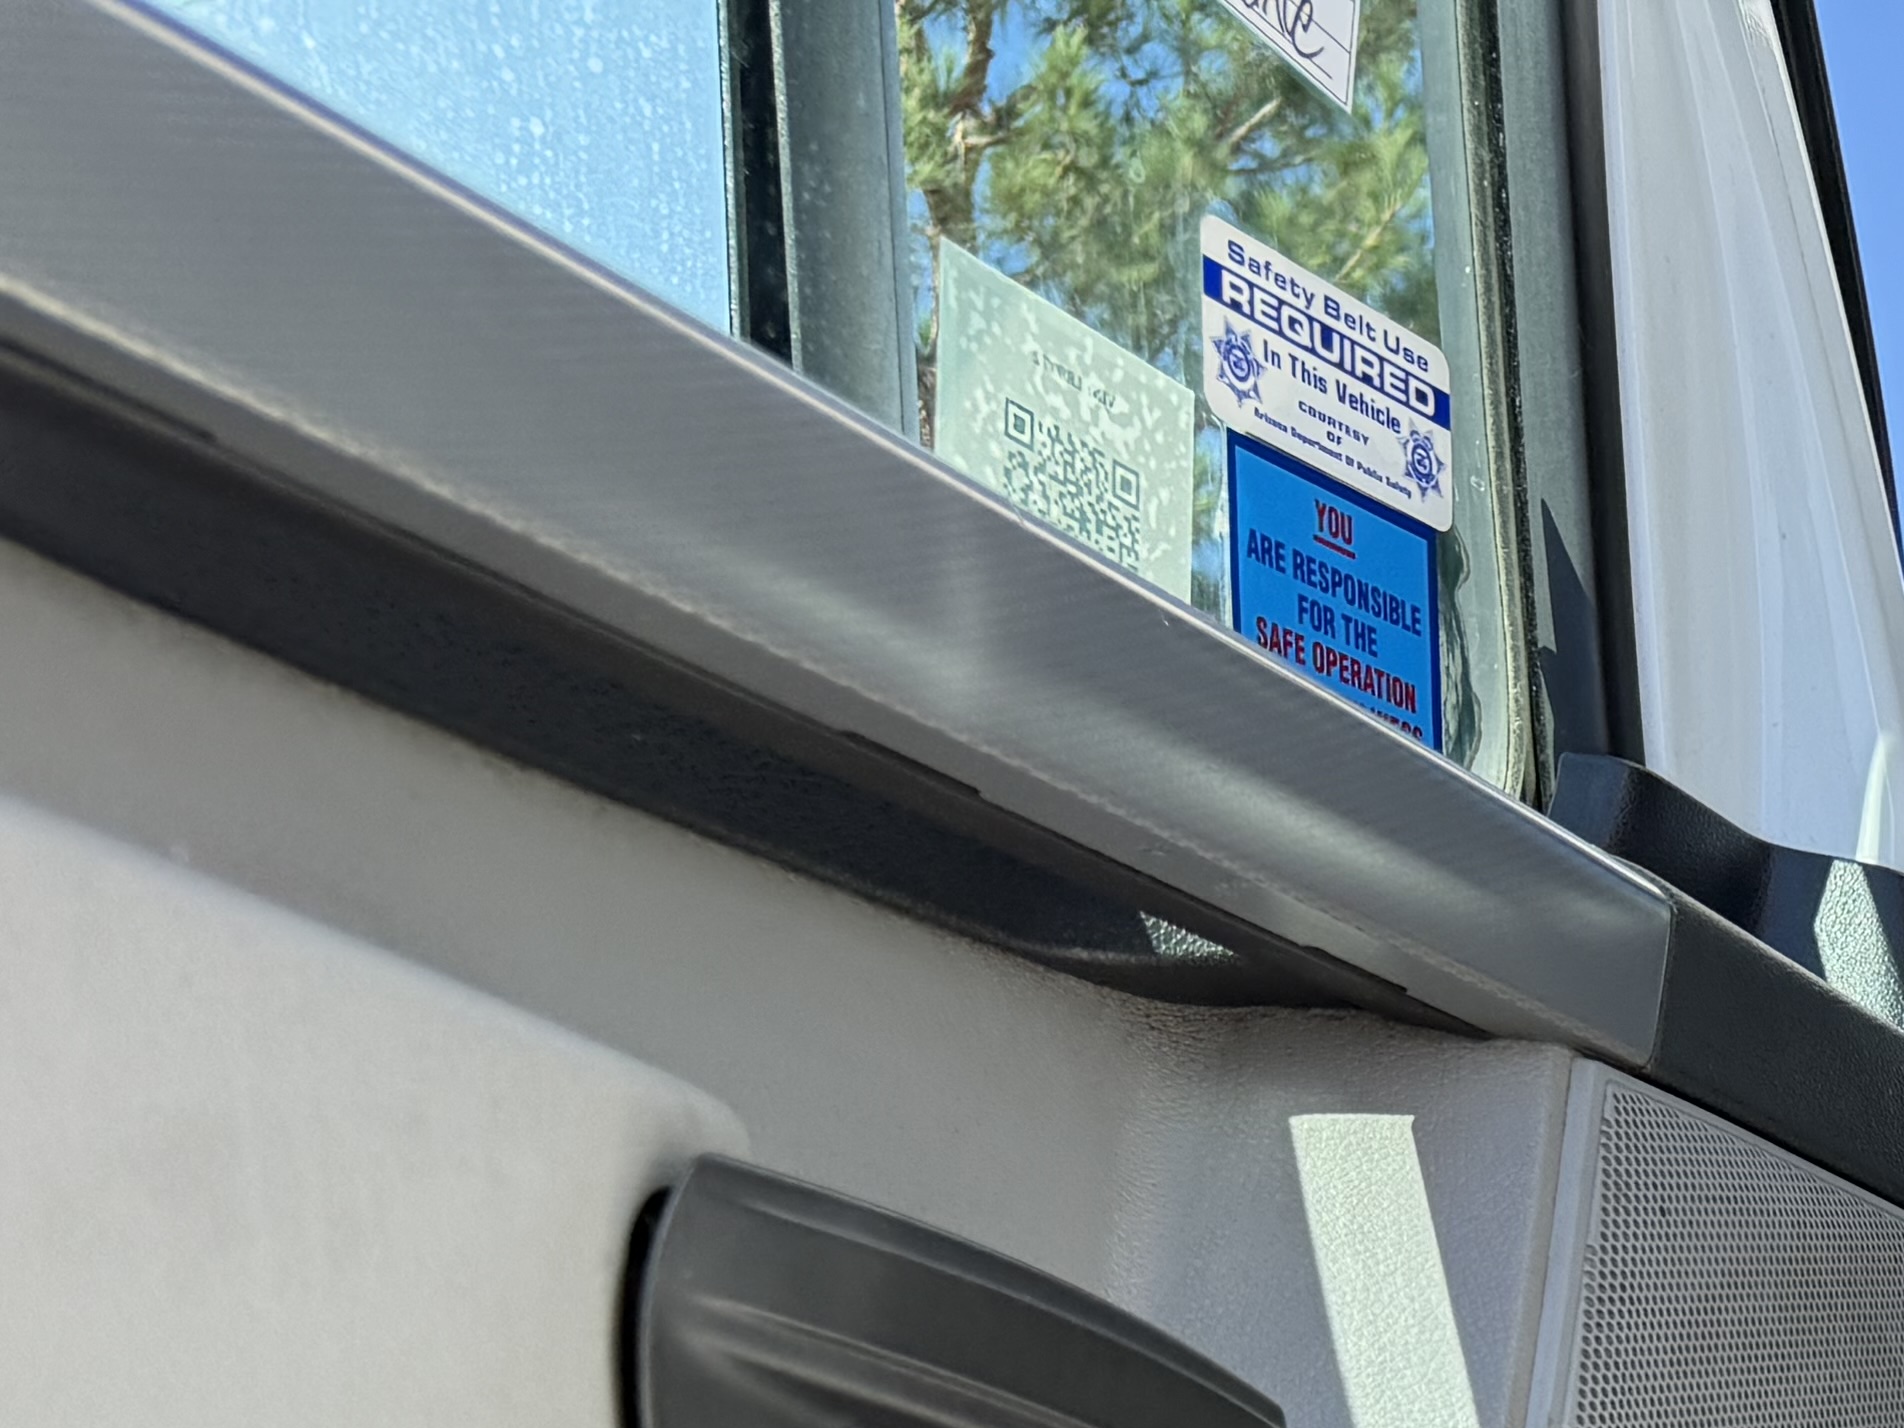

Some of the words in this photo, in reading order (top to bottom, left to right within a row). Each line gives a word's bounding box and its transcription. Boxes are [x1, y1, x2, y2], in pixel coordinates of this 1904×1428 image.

[1221, 268, 1436, 417] REQUIRED
[1227, 239, 1315, 309] Safety
[1324, 294, 1376, 341] Belt
[1383, 329, 1429, 372] Use
[1263, 339, 1282, 370] In
[1288, 353, 1328, 394] This
[1335, 379, 1401, 434] Vehicle
[1298, 400, 1369, 446] COURTESY
[1326, 431, 1342, 446] OF
[1314, 498, 1353, 546] YOU
[1247, 528, 1287, 574] ARE
[1292, 547, 1422, 638] RESPONSIBLE
[1297, 593, 1336, 639] FOR
[1341, 612, 1378, 658] THE
[1256, 615, 1306, 666] SAFE
[1312, 641, 1417, 714] OPERATION
